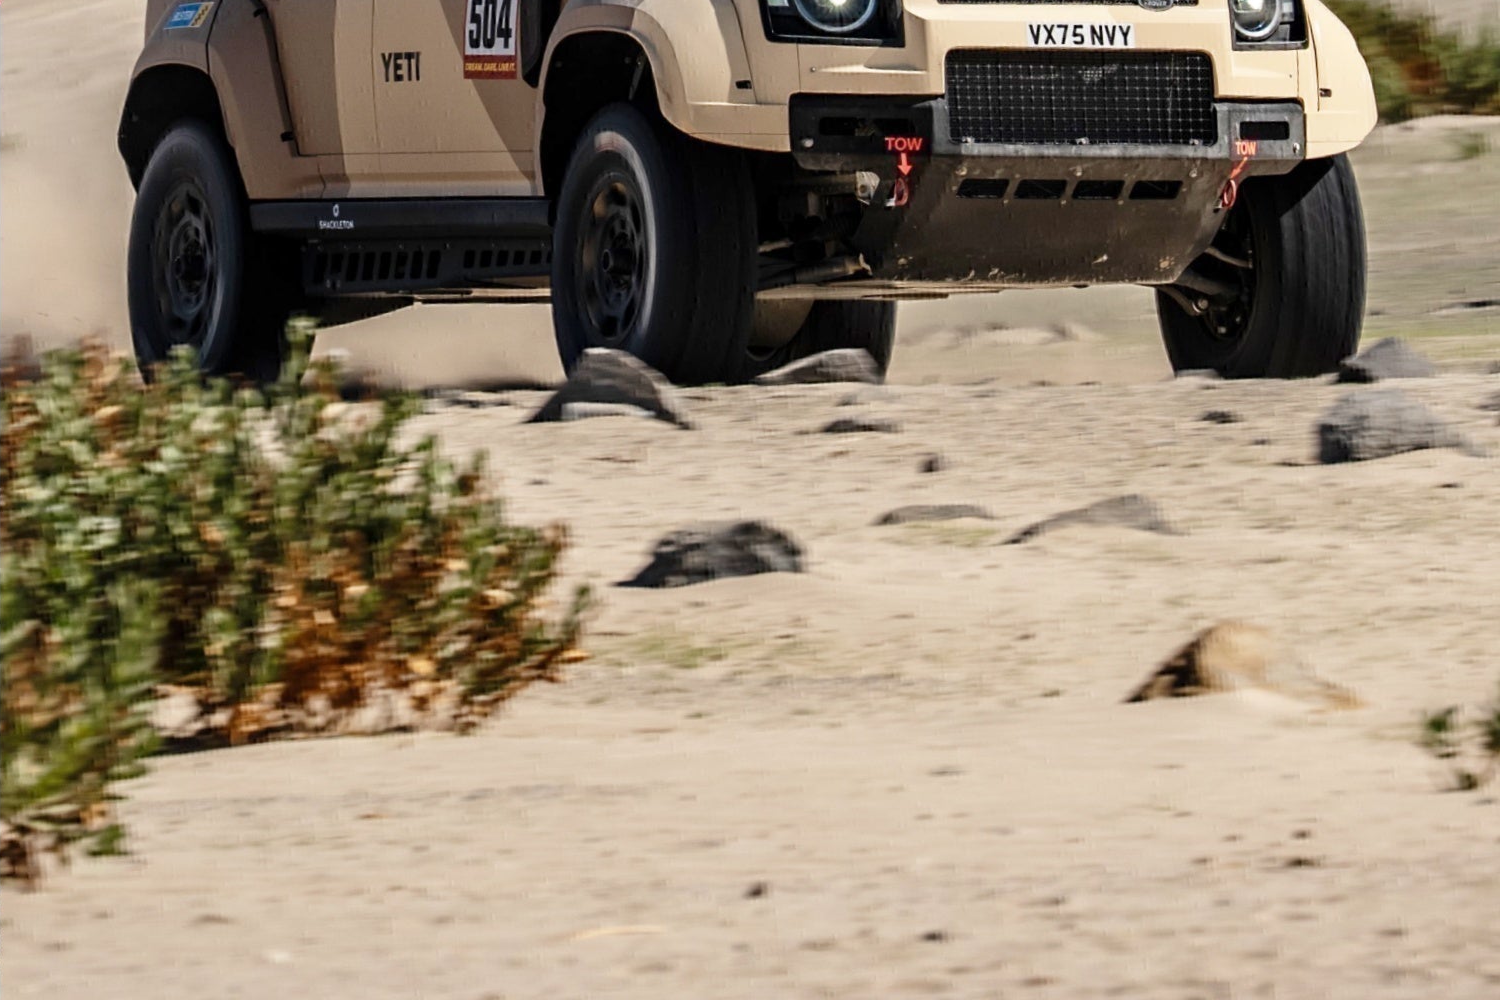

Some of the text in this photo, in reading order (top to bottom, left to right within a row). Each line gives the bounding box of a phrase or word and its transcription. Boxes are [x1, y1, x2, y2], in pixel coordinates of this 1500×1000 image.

[1028, 24, 1131, 46] VX75 NVY
[381, 51, 421, 82] YETI
[884, 137, 923, 151] TOW
[1235, 141, 1257, 155] TOW
